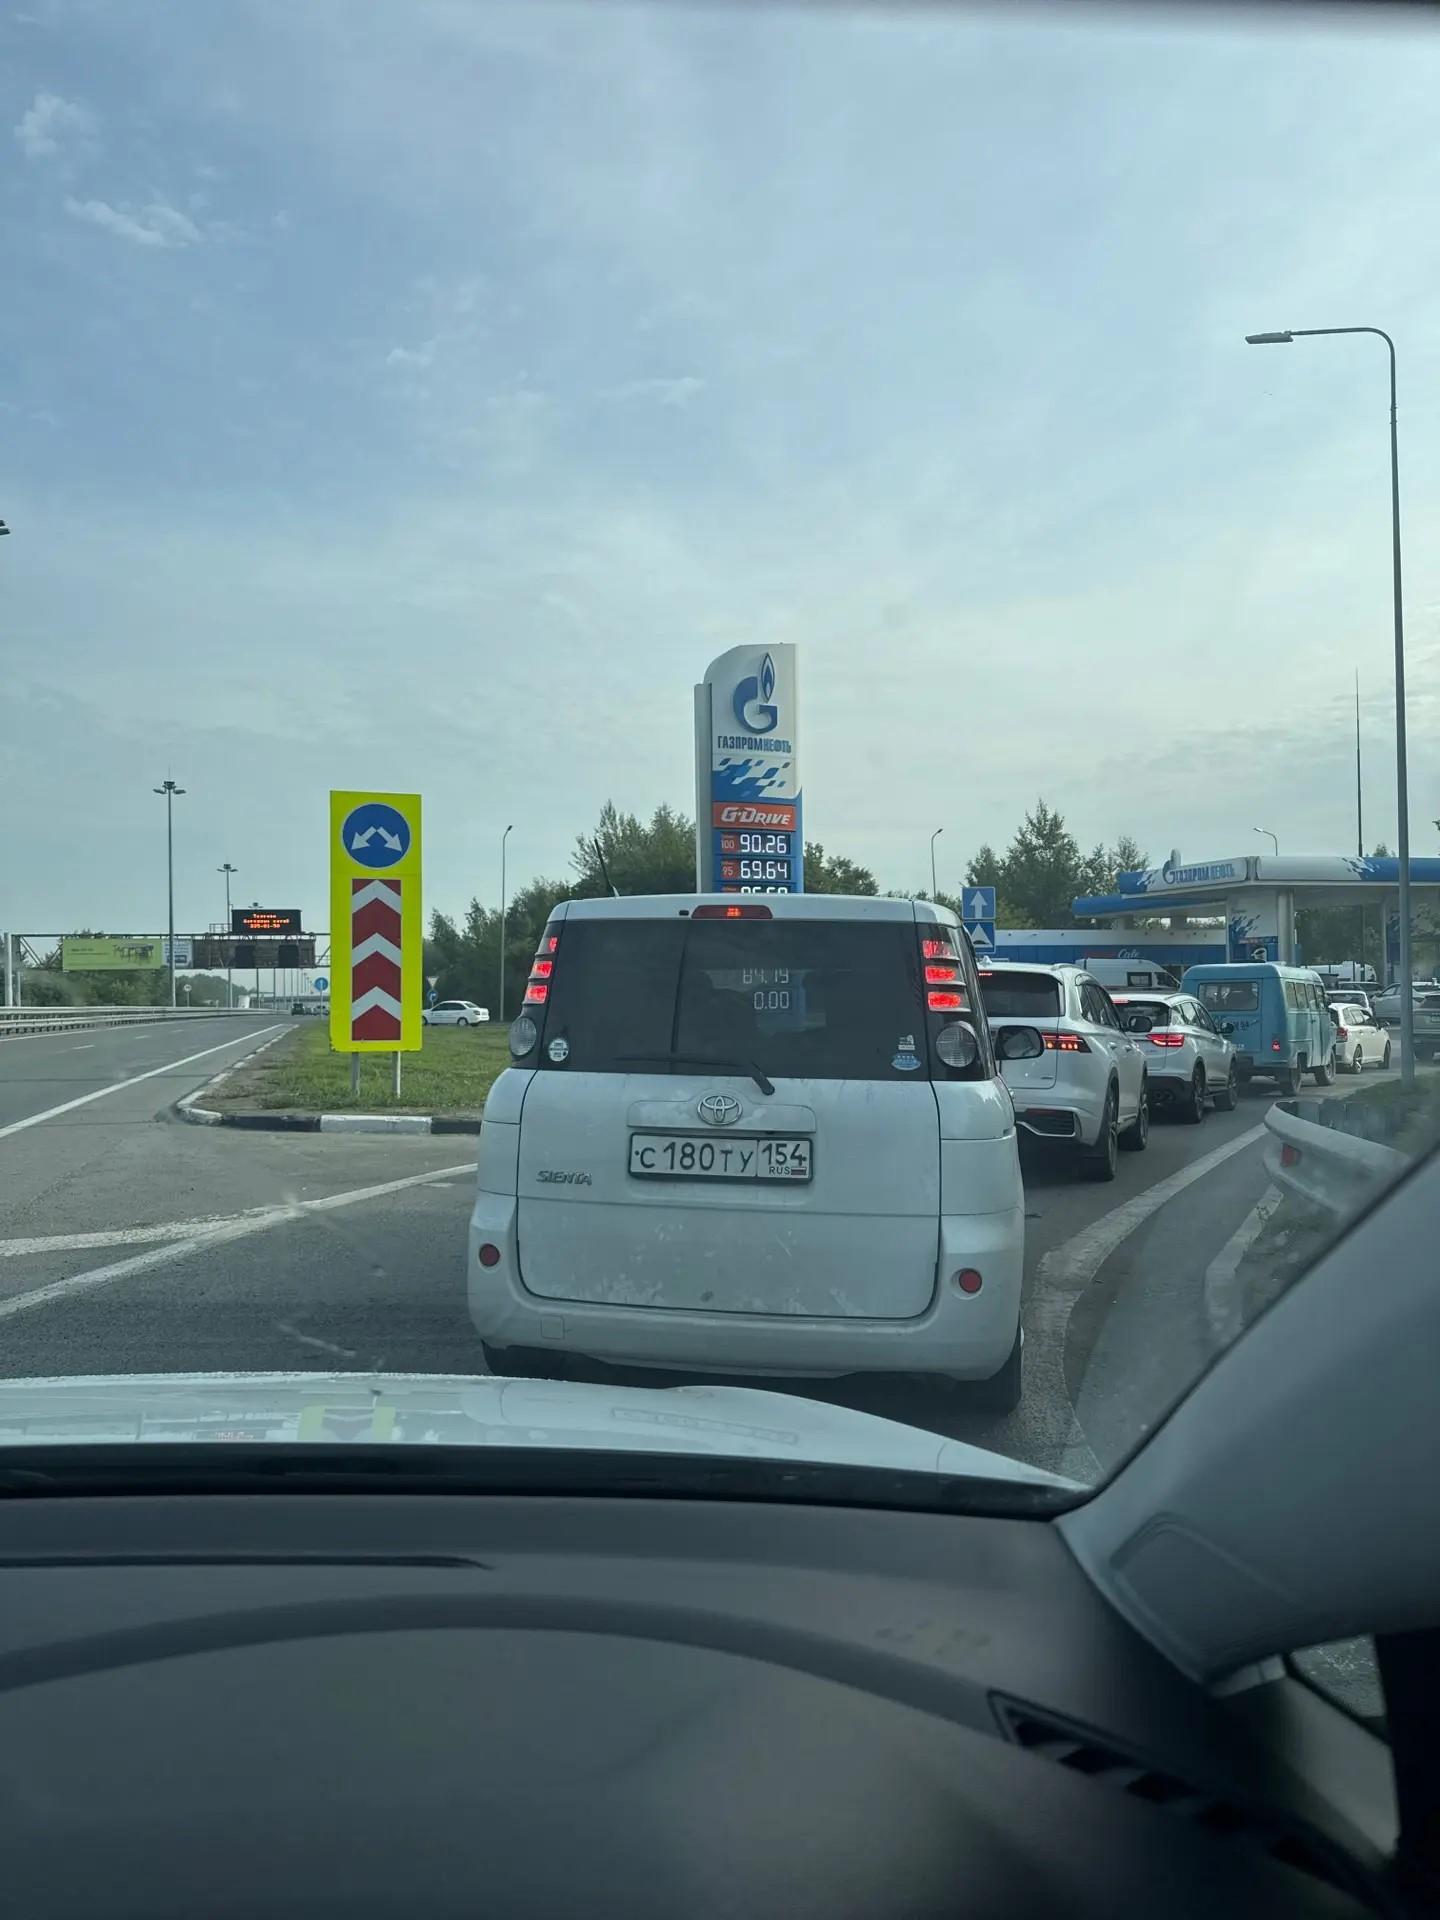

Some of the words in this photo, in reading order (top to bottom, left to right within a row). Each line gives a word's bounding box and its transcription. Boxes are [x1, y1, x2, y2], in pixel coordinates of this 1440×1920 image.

[718, 736, 791, 753] ГАЗПРОМНЕФТЬ
[721, 839, 735, 849] 100
[740, 834, 787, 854] 90.26
[740, 860, 788, 879] 69.64
[762, 1143, 804, 1166] 154
[536, 1170, 592, 1186] SIENTA
[769, 1166, 790, 1175] RUS
